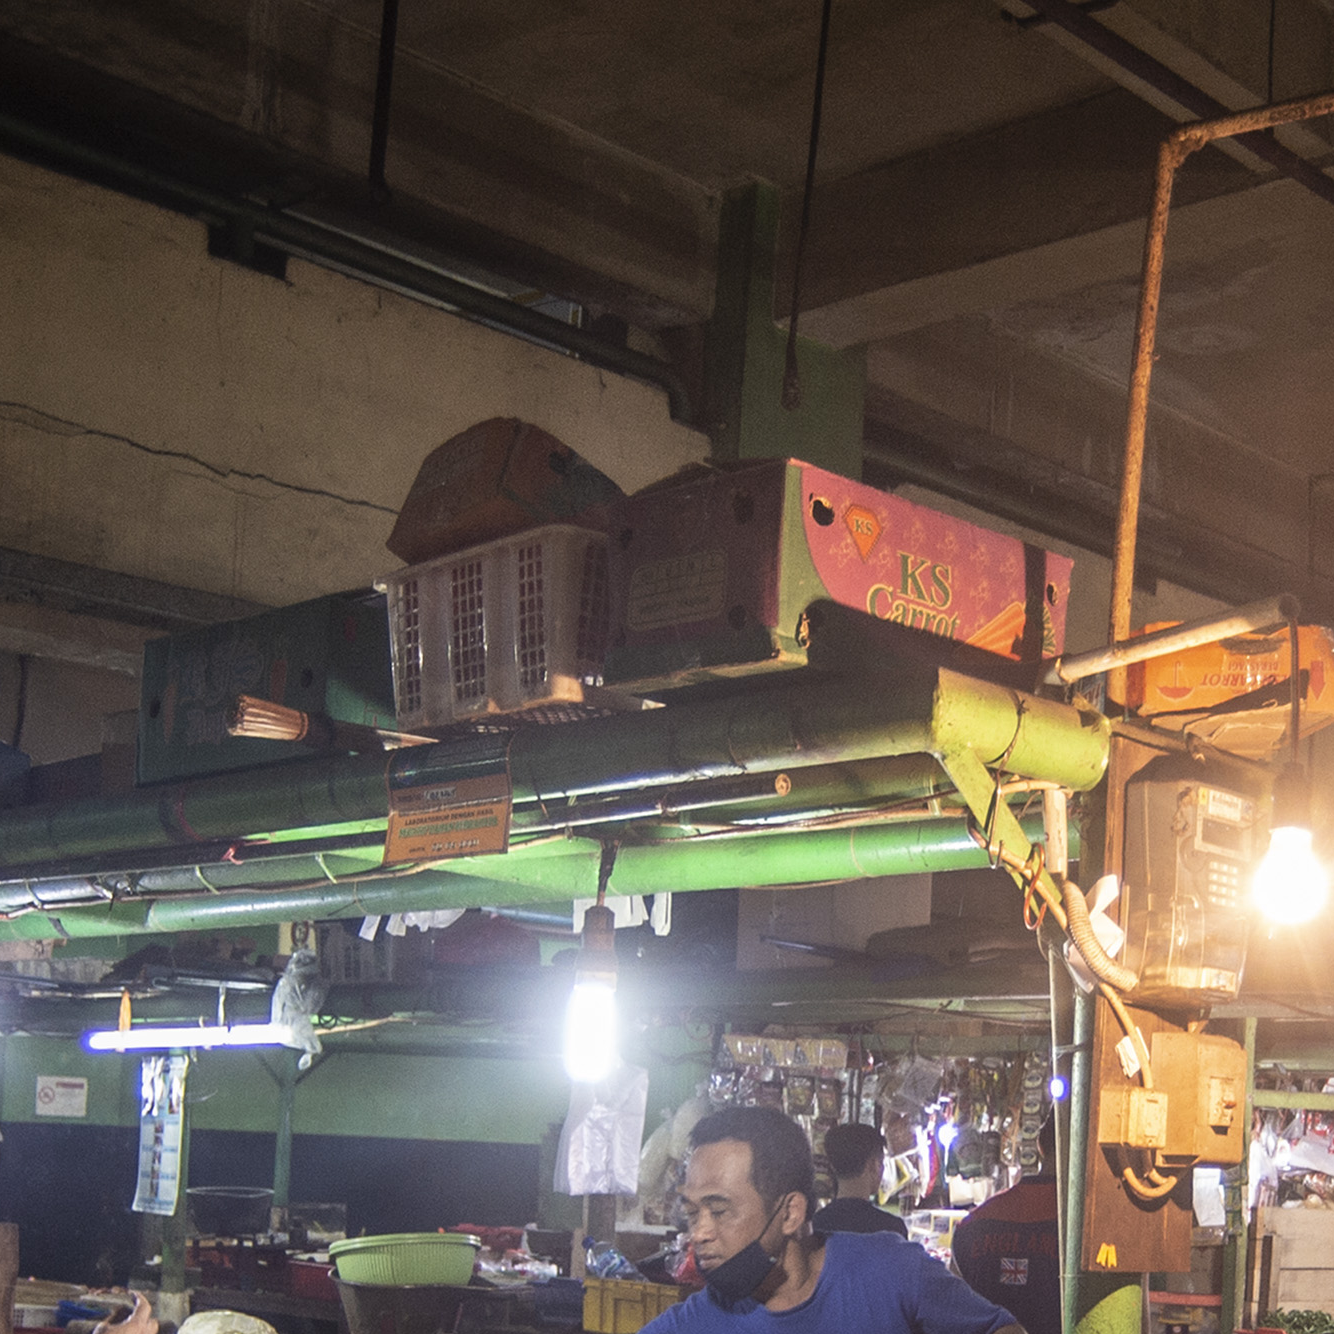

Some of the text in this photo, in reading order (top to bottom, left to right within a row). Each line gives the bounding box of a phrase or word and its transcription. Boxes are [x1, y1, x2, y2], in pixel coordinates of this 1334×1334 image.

[854, 518, 873, 535] KS
[896, 551, 952, 611] KS
[866, 583, 961, 641] Carrot
